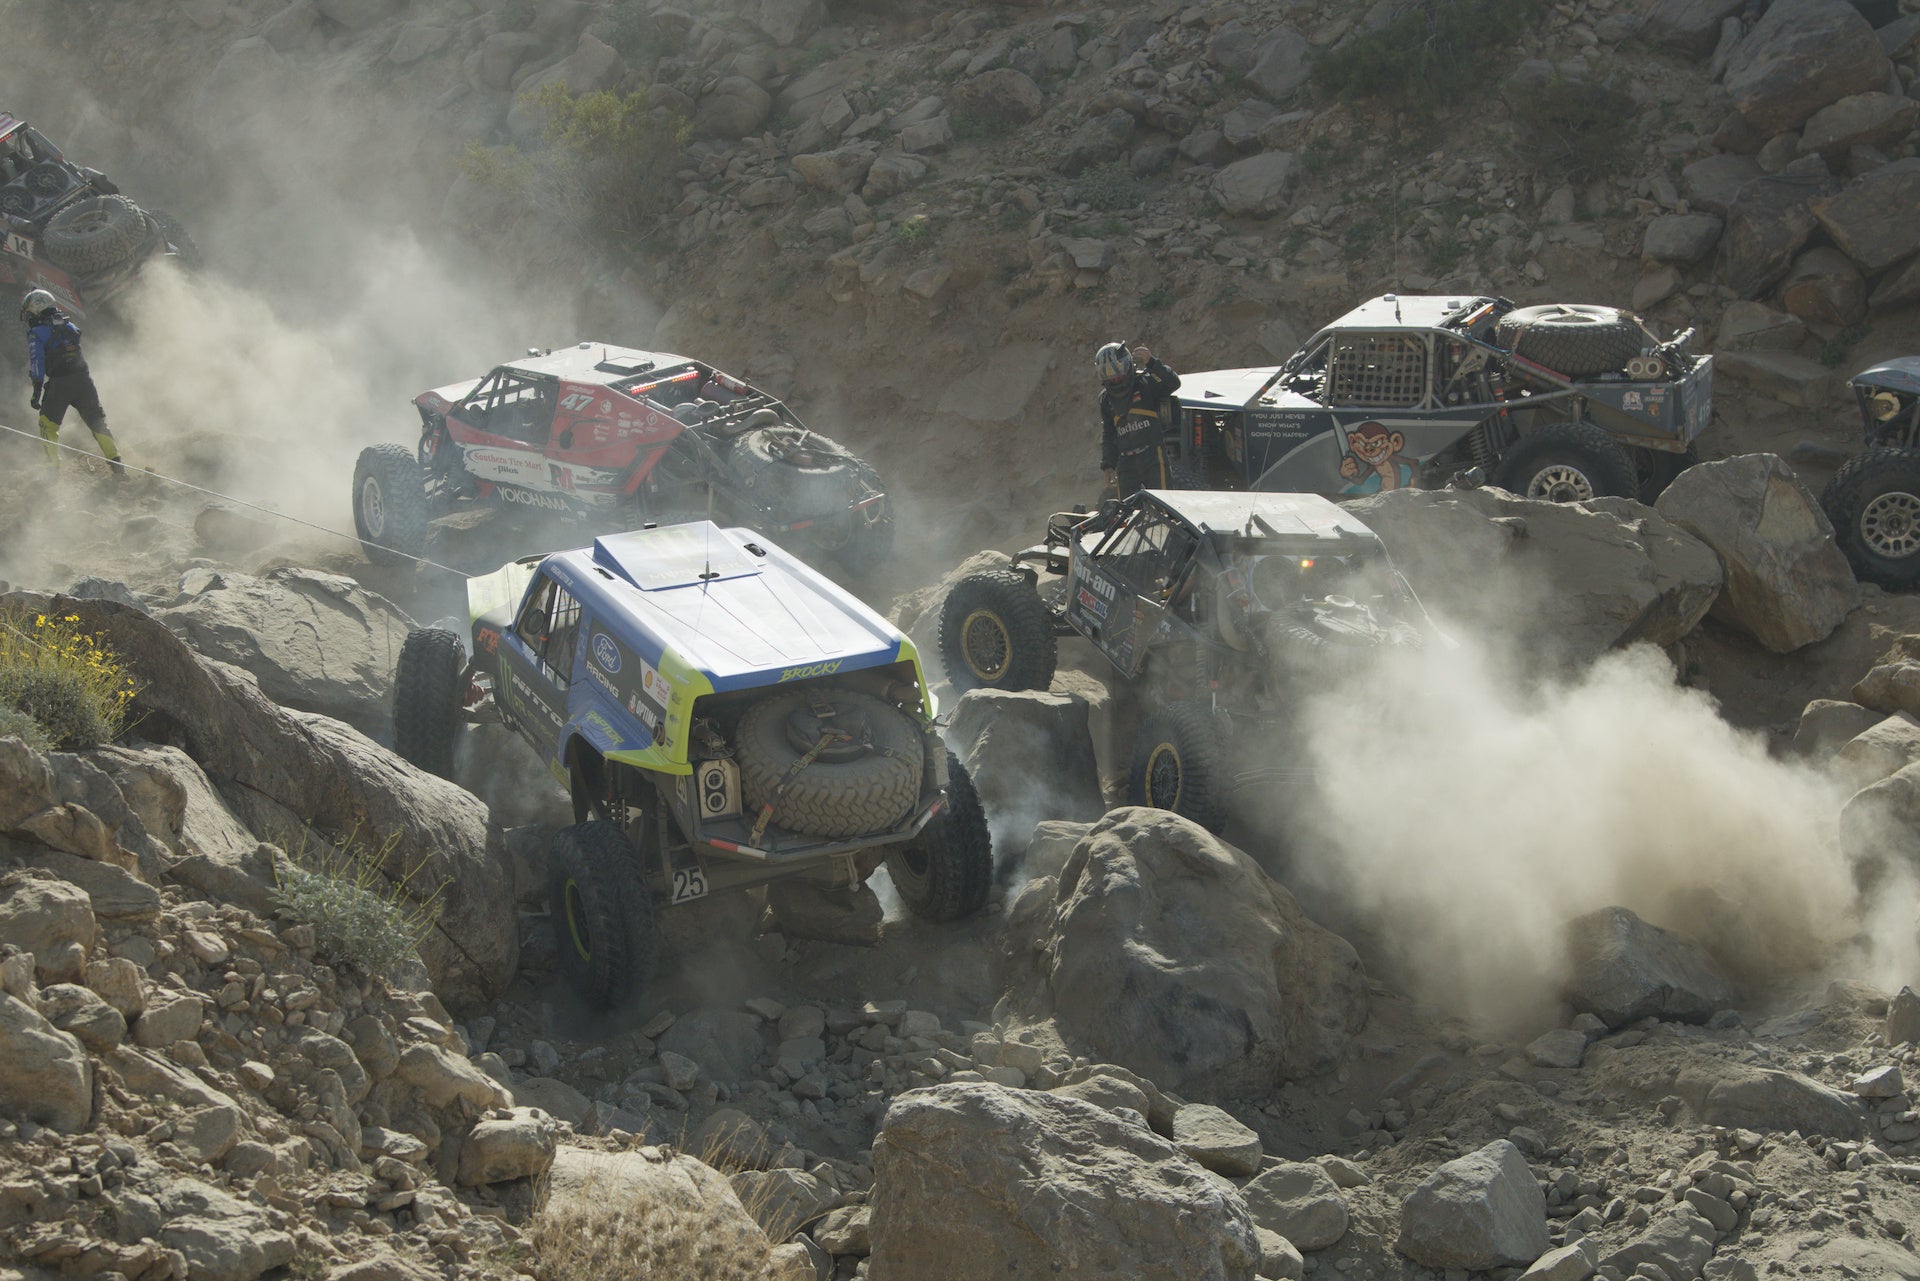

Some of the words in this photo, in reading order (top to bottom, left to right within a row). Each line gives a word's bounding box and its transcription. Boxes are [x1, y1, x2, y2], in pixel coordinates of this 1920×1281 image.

[14, 236, 29, 256] 14
[560, 394, 595, 412] 47
[474, 452, 507, 465] Southern
[509, 457, 523, 467] Tire
[524, 460, 543, 472] Mart
[497, 487, 571, 512] YOKOHAMA
[1073, 556, 1116, 601] can-am
[597, 637, 617, 669] Ford
[586, 660, 619, 698] RACING
[777, 659, 844, 683] BROCKY
[635, 699, 657, 728] OPTIMA
[674, 867, 705, 900] 25
